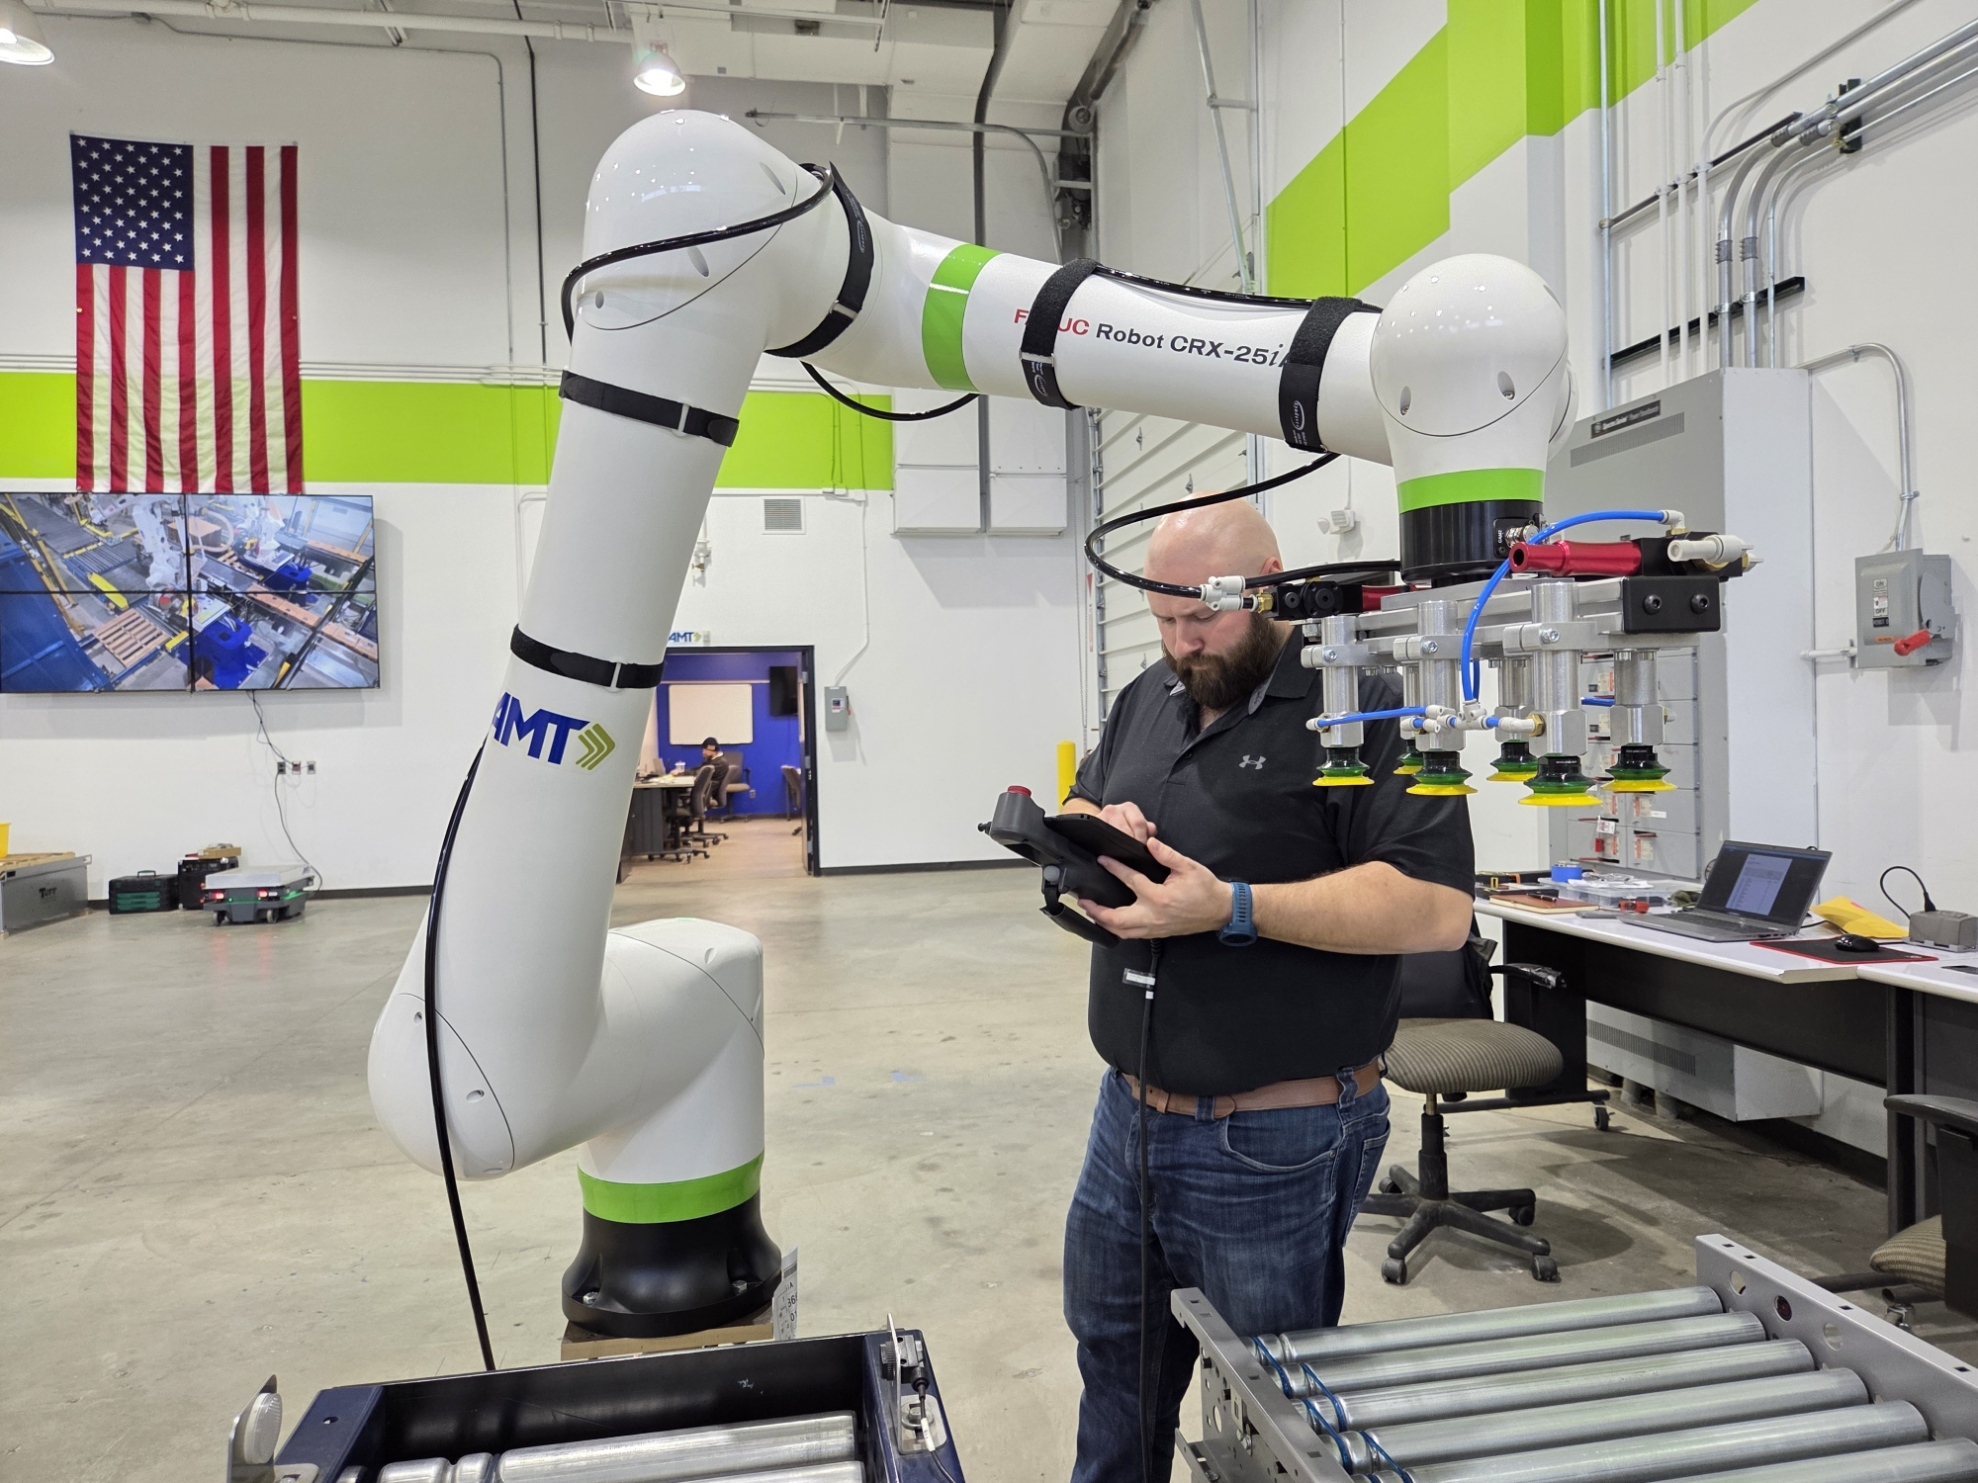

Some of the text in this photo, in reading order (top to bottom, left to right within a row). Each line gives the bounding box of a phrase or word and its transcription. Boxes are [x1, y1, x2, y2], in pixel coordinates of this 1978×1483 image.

[1014, 308, 1290, 367] FUC Robot CRX-25i
[668, 631, 695, 643] AMT
